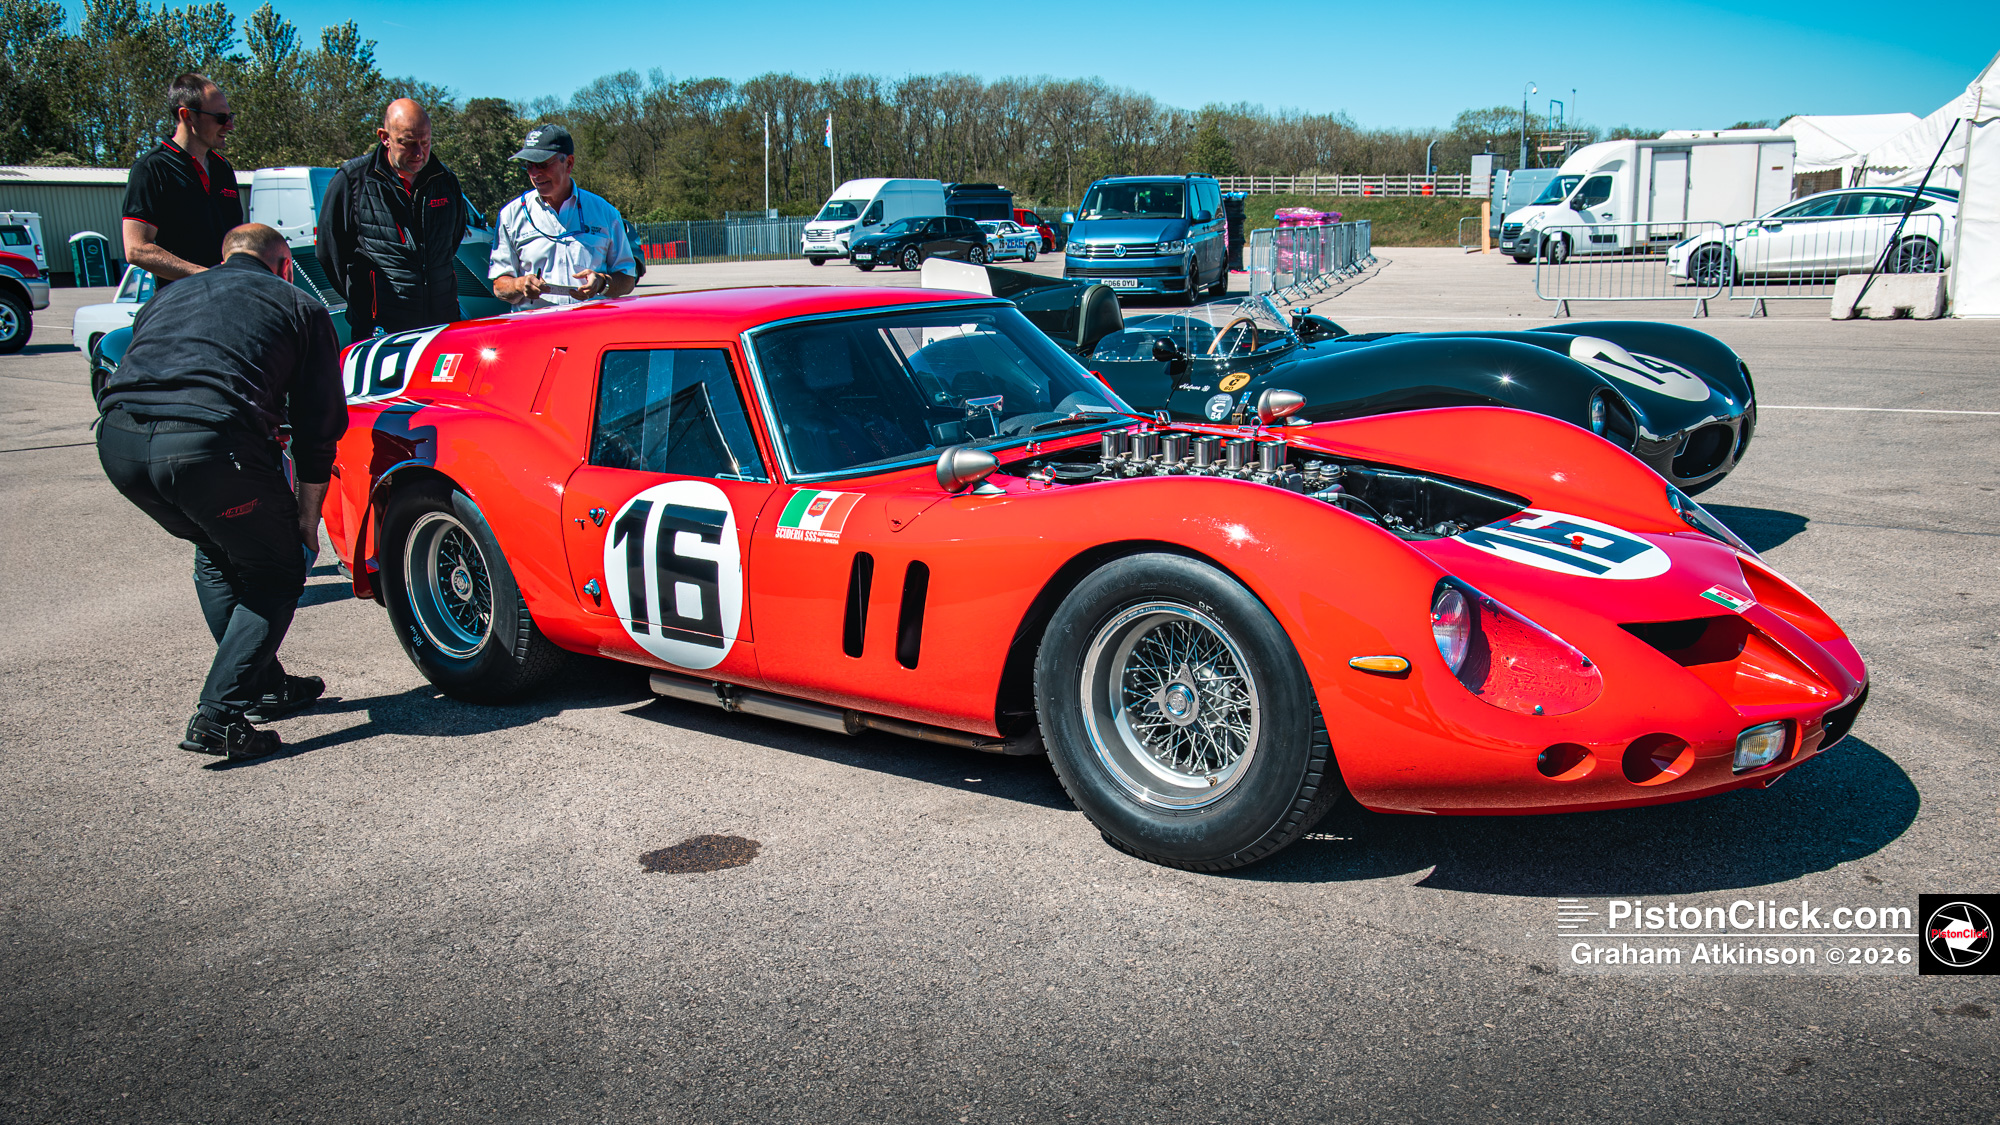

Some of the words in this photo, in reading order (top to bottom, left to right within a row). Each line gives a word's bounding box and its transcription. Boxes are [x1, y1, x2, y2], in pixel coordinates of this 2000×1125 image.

[1007, 237, 1026, 249] ZEXEL
[1592, 351, 1693, 386] 14
[1211, 403, 1226, 413] C
[1210, 412, 1222, 420] 54
[775, 528, 804, 540] SCUDERIA
[804, 530, 817, 542] SSS
[613, 499, 728, 650] 16
